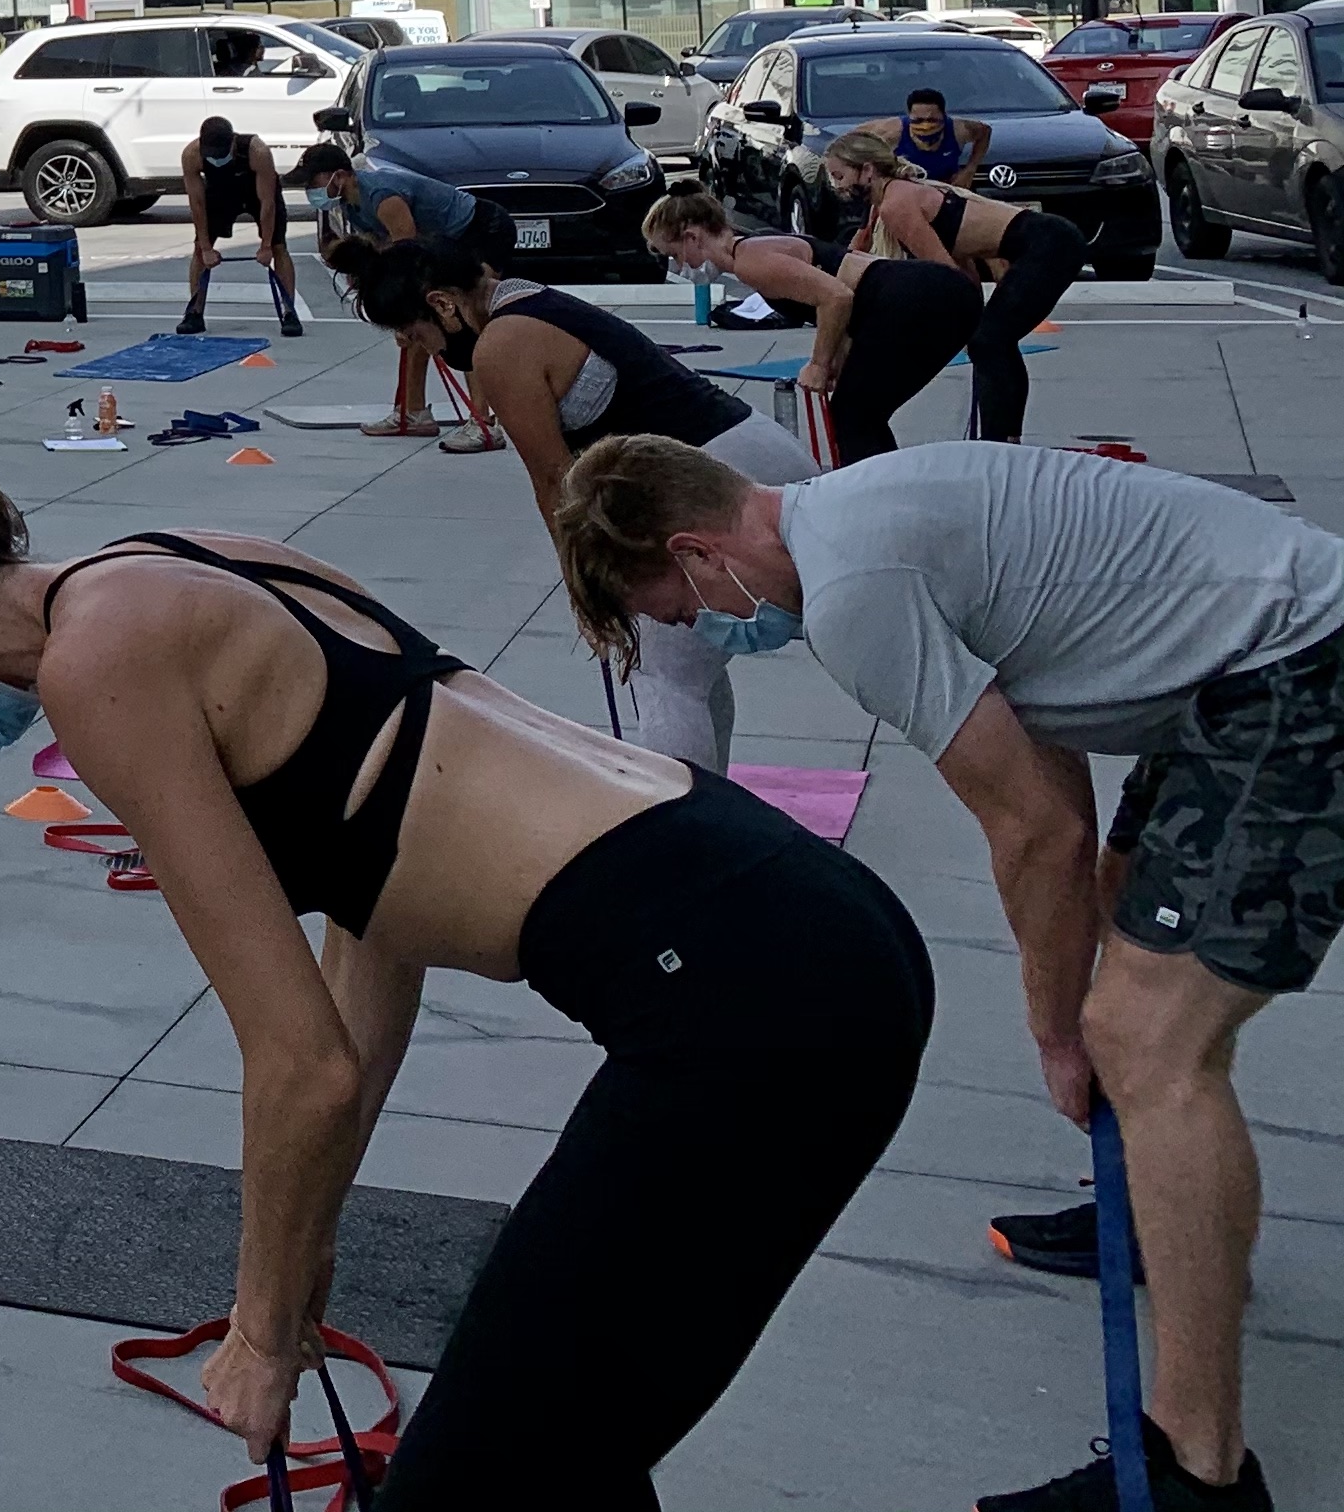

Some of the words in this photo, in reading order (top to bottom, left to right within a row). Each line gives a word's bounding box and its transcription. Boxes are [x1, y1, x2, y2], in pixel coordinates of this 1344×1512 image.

[417, 26, 439, 34] YOU
[417, 35, 440, 43] FOR?
[519, 230, 547, 244] J740
